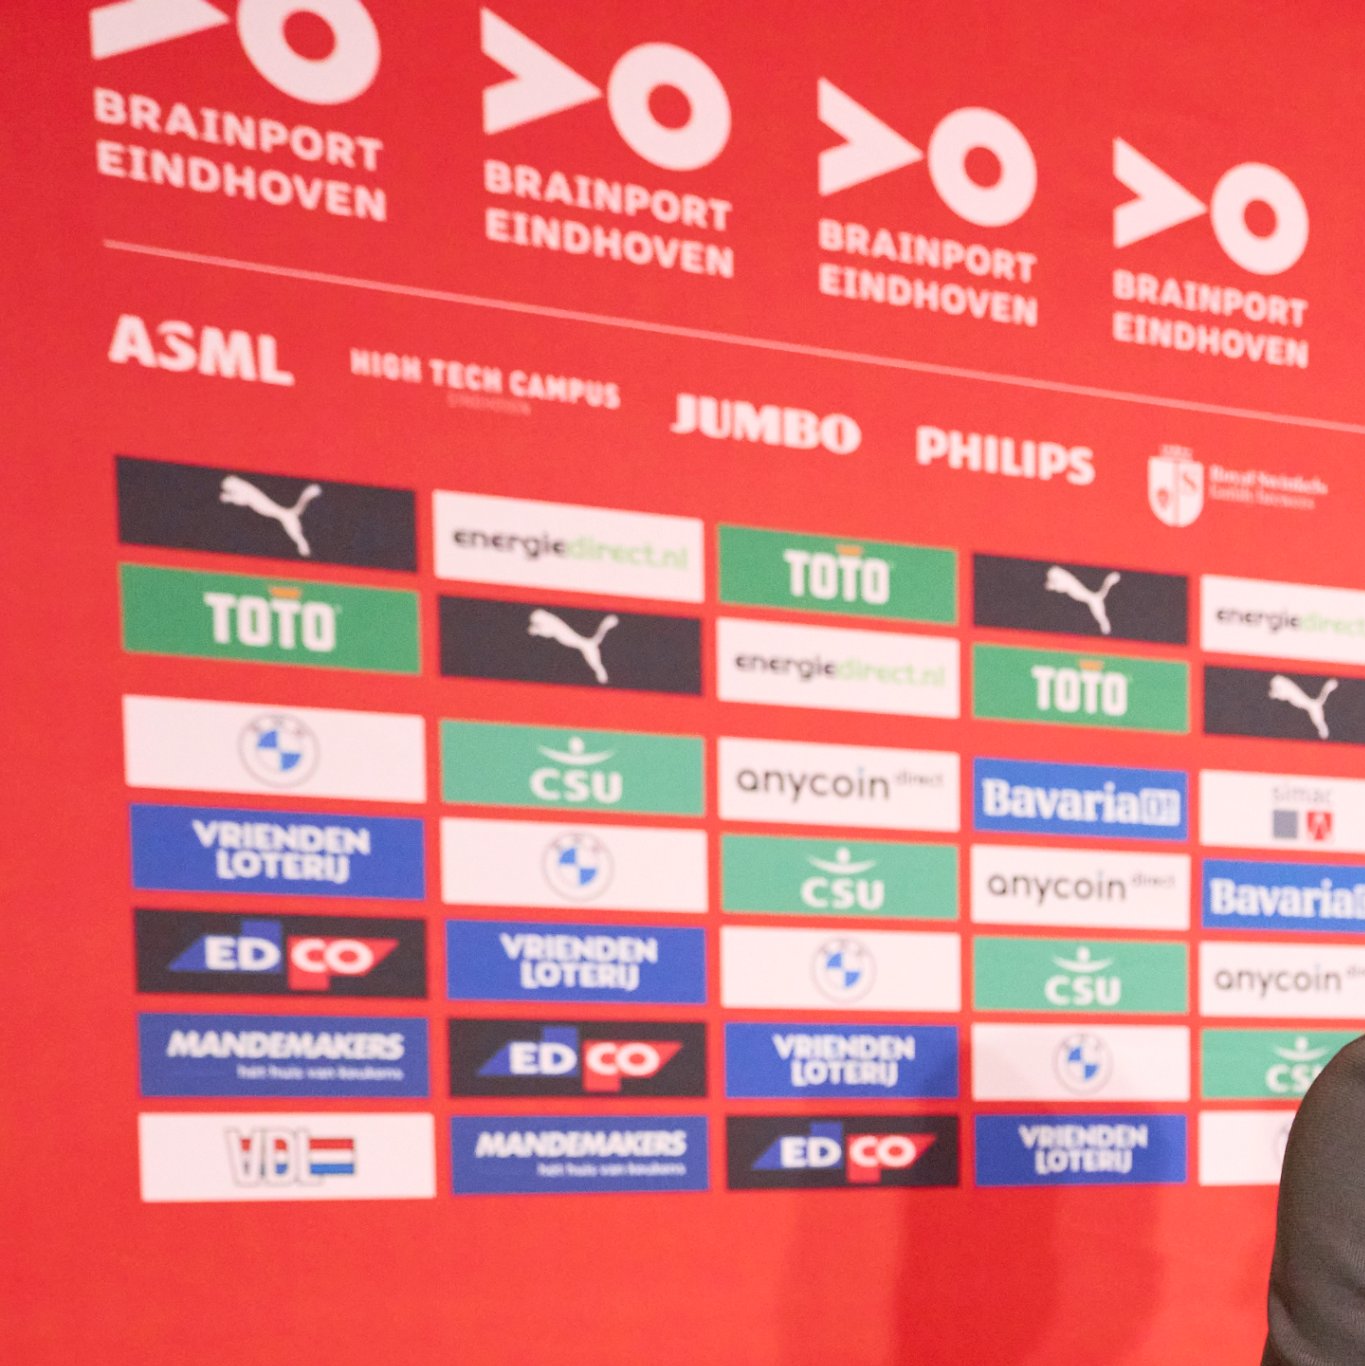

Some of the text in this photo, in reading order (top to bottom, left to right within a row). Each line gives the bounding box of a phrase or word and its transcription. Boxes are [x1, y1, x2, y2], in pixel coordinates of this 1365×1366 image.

[93, 87, 384, 173] BRAINPORT
[96, 140, 387, 223] EINDHOVEN
[483, 160, 733, 233] BRAINPORT
[485, 207, 734, 279] EINDHOVEN
[818, 218, 1038, 283] BRAINPORT
[818, 263, 1039, 327] EINDHOVEN
[1113, 269, 1308, 327] BRAINPORT
[1113, 312, 1309, 369] EINDHOVEN
[107, 314, 295, 387] ASML
[350, 347, 422, 384] HIGH
[429, 357, 504, 396] TECH
[508, 367, 622, 410] CAMPUS
[669, 394, 863, 456] JUMBO
[915, 425, 1096, 487] PHILIPS
[453, 526, 689, 571] energiedirect.nl
[783, 548, 890, 605] TOTO
[203, 591, 338, 653] TOTO
[734, 651, 945, 689] energiedirect.nl
[1032, 664, 1128, 716] TOTO
[529, 769, 623, 803] CSU
[736, 766, 890, 803] anycoin
[982, 778, 1140, 825] Bavaria
[191, 820, 370, 854] VRIENDEN
[217, 850, 350, 884] LOTERIJ
[801, 877, 884, 910] CSU
[986, 870, 1126, 906] anycoin
[1209, 877, 1353, 919] Bavaria
[500, 932, 658, 964] VRIENDEN
[521, 960, 639, 990] LOTERIJ
[1045, 975, 1121, 1006] CSU
[1214, 964, 1342, 997] anycoin
[167, 1030, 405, 1060] MANDEMAKERS
[772, 1034, 915, 1060] VRIENDEN
[791, 1057, 898, 1087] LOTERIJ
[475, 1130, 687, 1159] MANDEMAKERS
[1019, 1124, 1148, 1151] VRIENDEN
[1035, 1147, 1132, 1174] LOTERIJ
